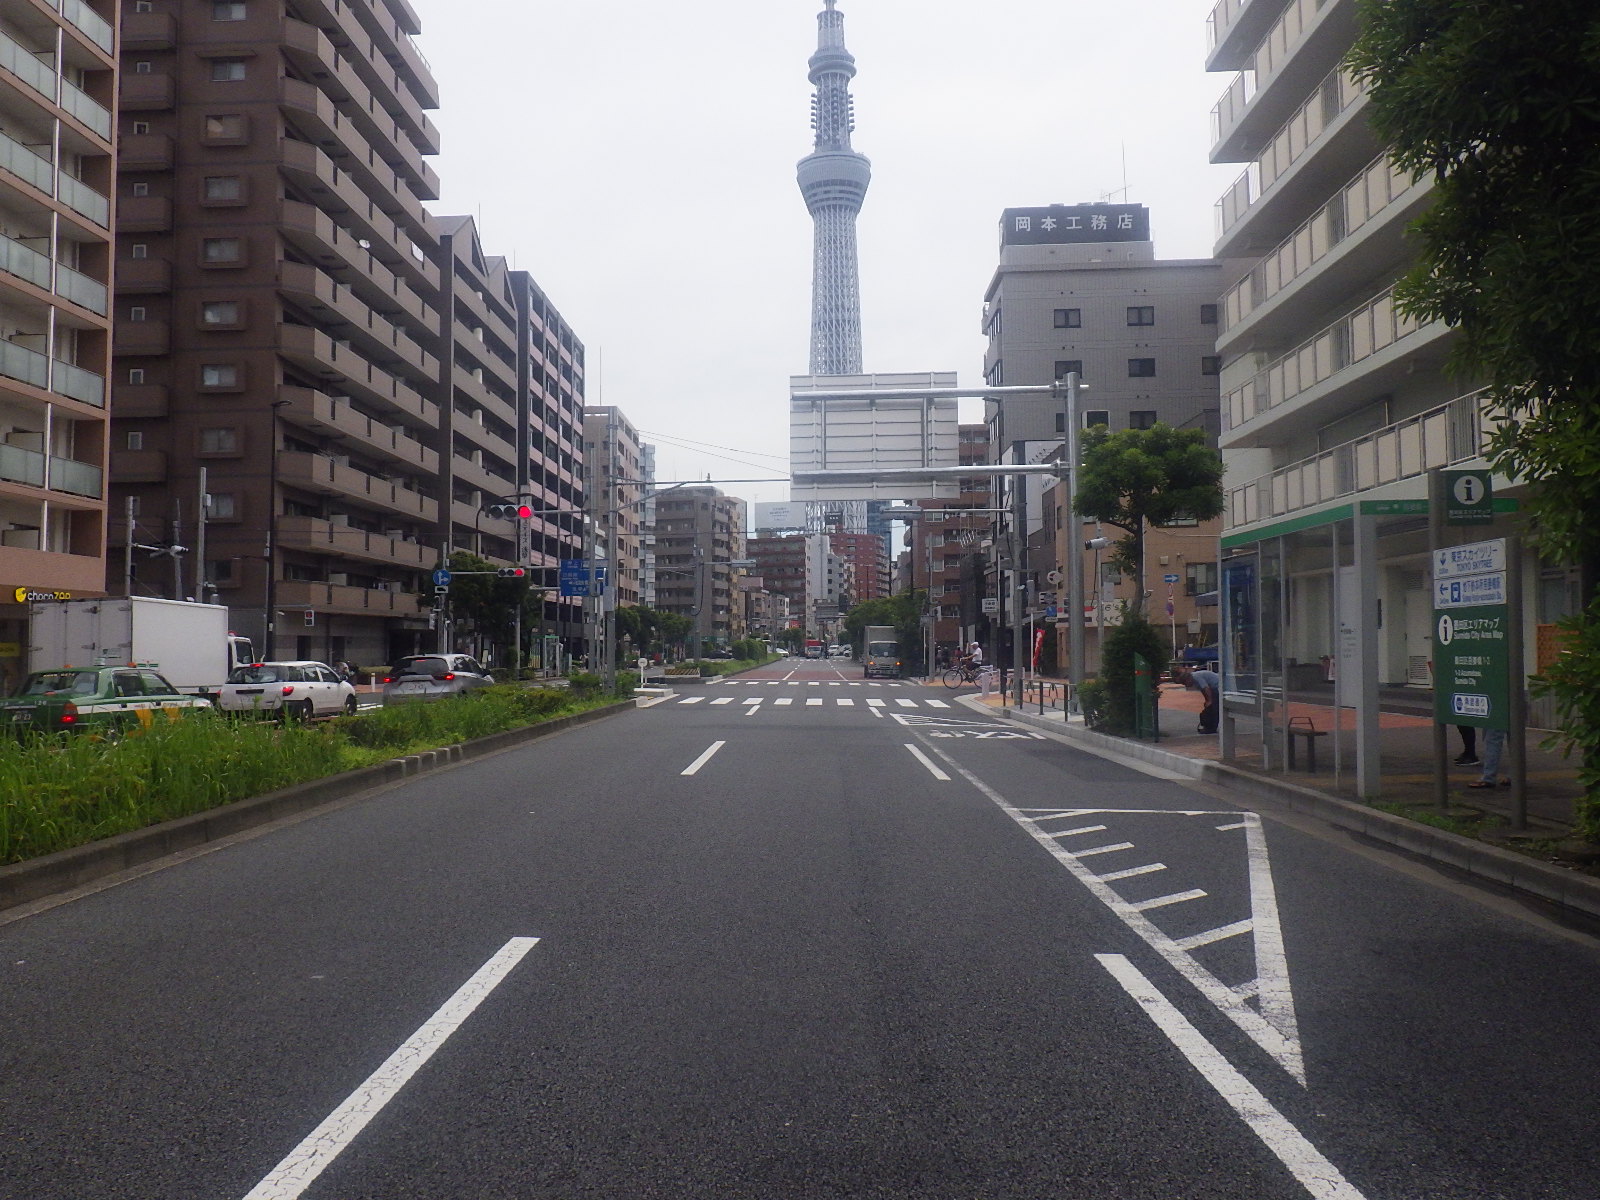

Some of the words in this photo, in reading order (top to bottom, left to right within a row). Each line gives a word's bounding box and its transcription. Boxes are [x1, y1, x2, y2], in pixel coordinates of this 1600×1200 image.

[1015, 213, 1134, 232] 岡本工務店
